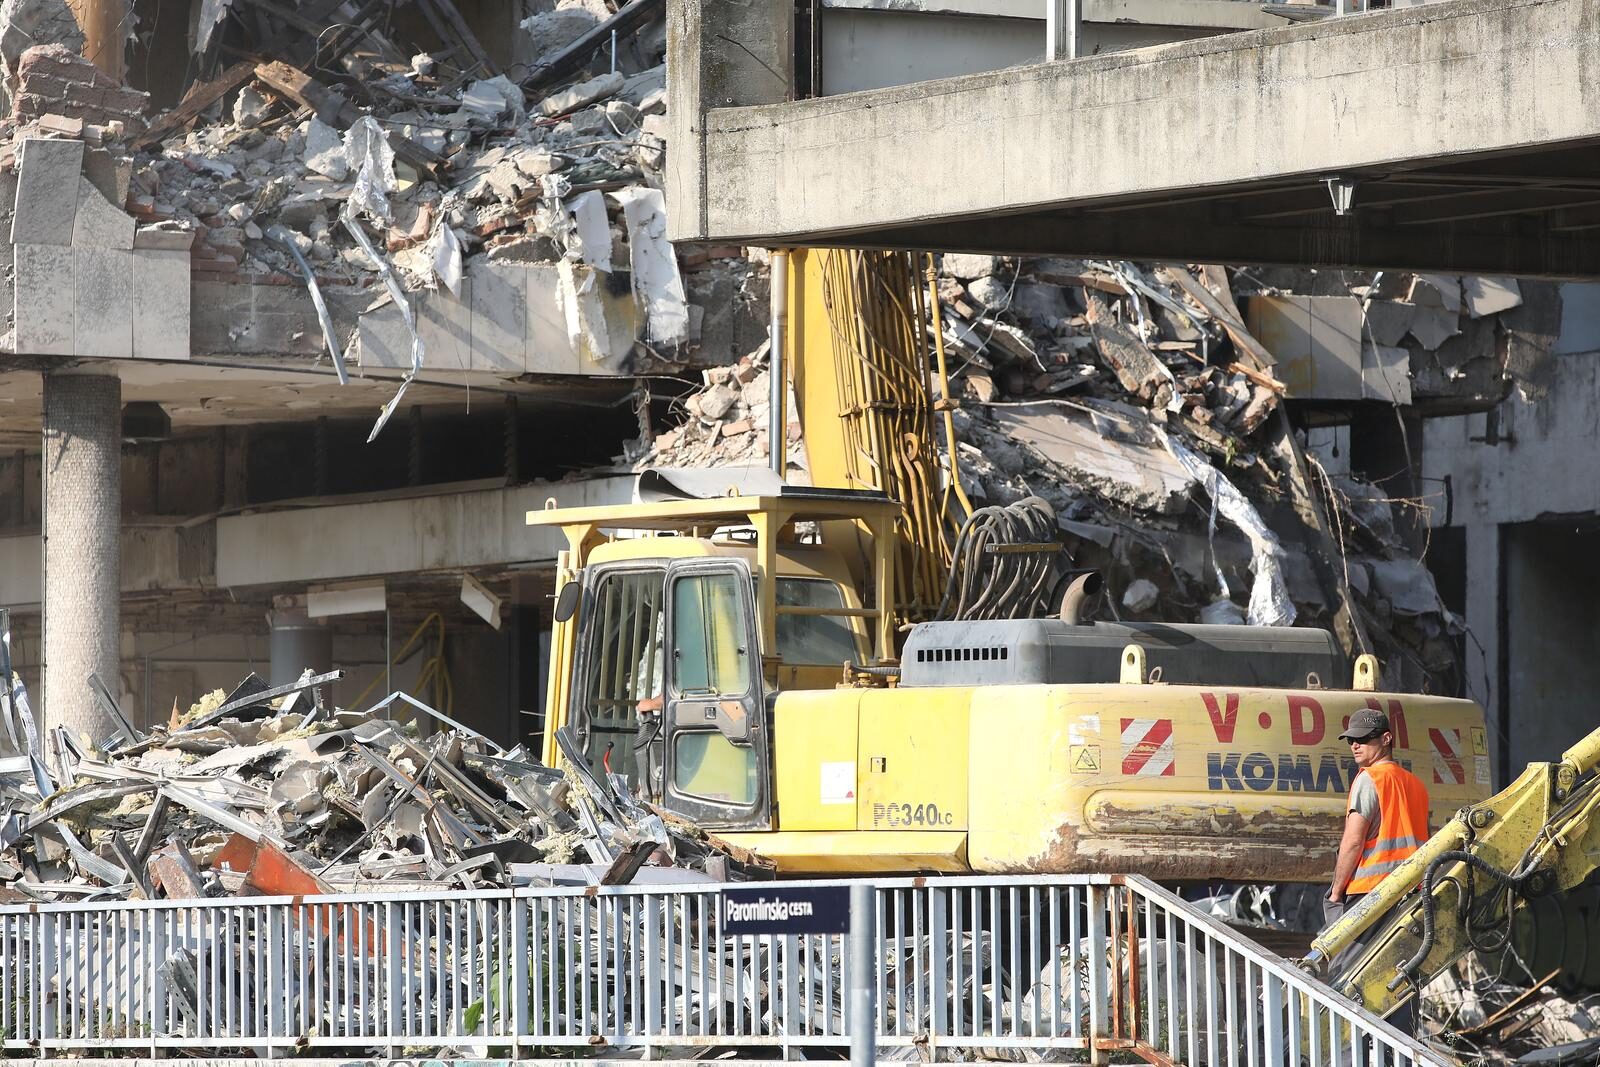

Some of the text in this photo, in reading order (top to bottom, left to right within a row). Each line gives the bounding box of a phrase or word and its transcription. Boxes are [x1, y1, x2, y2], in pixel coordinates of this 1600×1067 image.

[1207, 752, 1412, 793] KOMAT
[727, 897, 813, 922] Paromlinska CESTA
